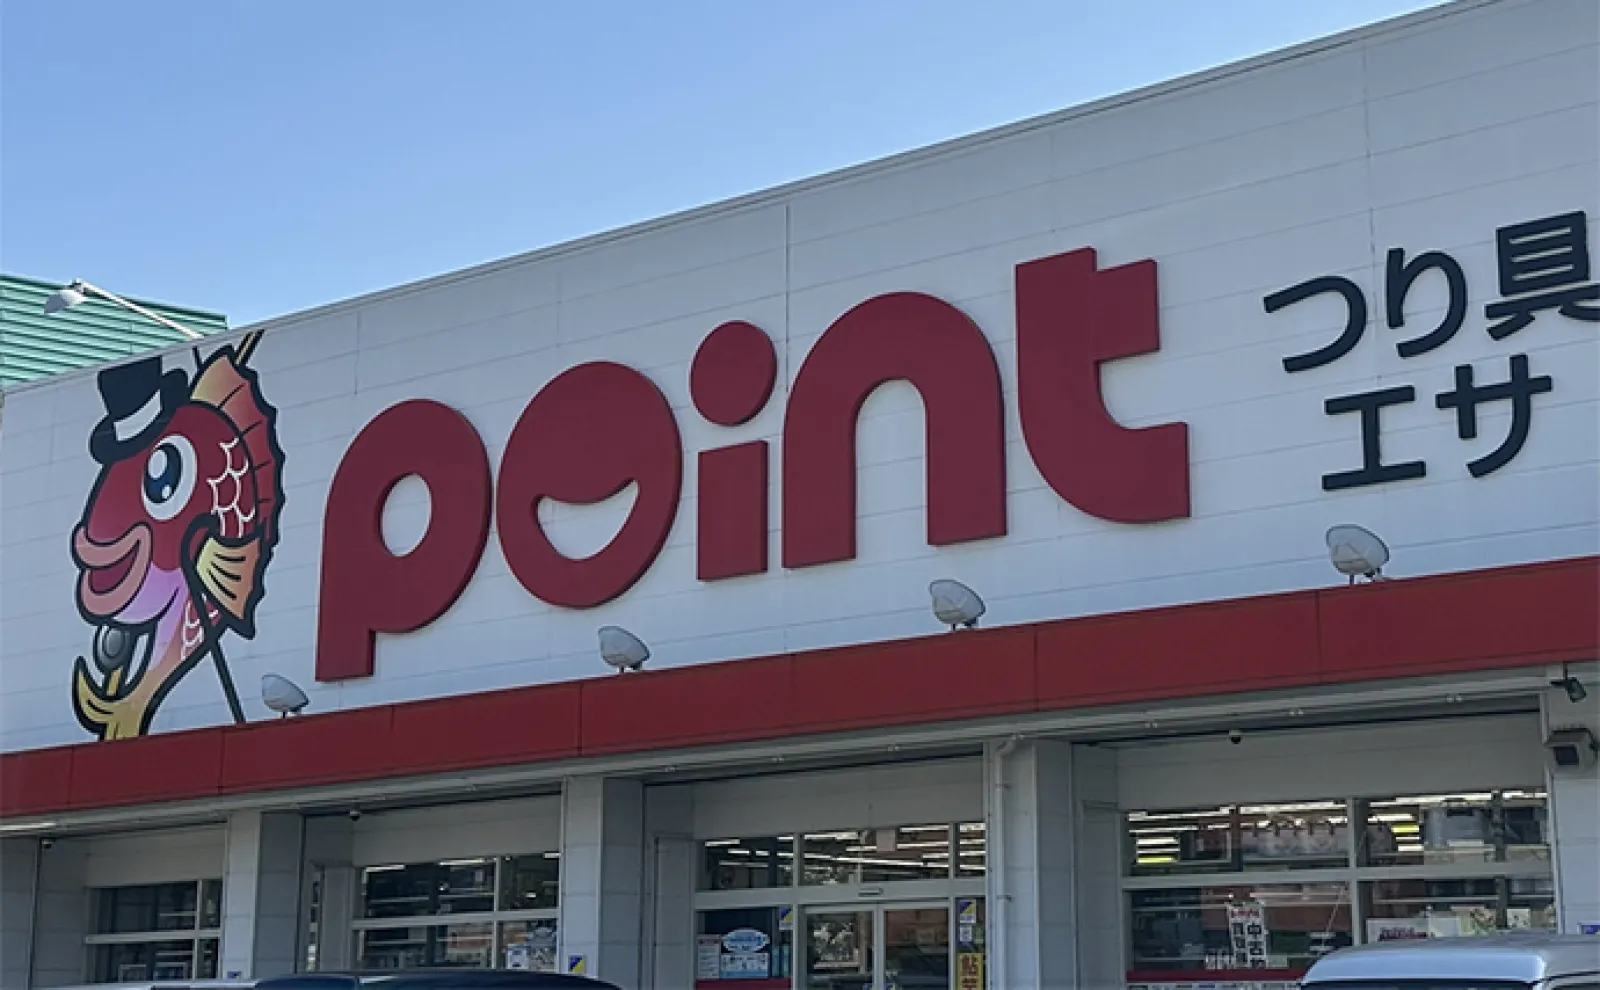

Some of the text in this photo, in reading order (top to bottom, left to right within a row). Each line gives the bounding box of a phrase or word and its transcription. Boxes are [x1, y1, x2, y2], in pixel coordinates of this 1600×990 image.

[1263, 210, 1600, 373] つり具
[315, 247, 1191, 682] point
[1322, 353, 1552, 491] エサ
